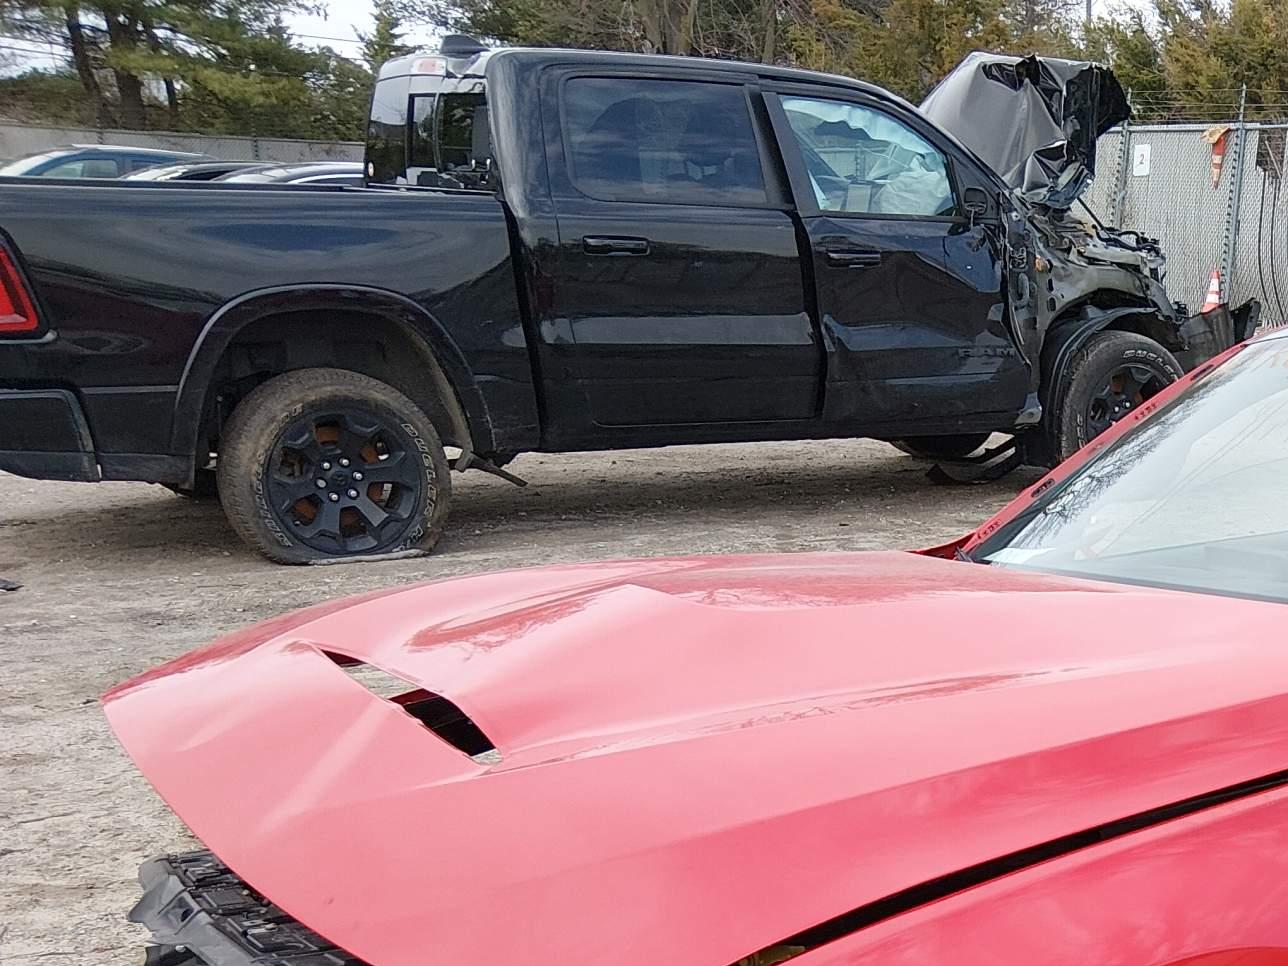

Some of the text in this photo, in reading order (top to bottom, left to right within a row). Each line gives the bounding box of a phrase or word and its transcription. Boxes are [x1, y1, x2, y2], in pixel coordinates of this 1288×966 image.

[1139, 154, 1145, 165] 2
[959, 348, 1017, 358] RAM
[401, 423, 438, 517] DUELER
